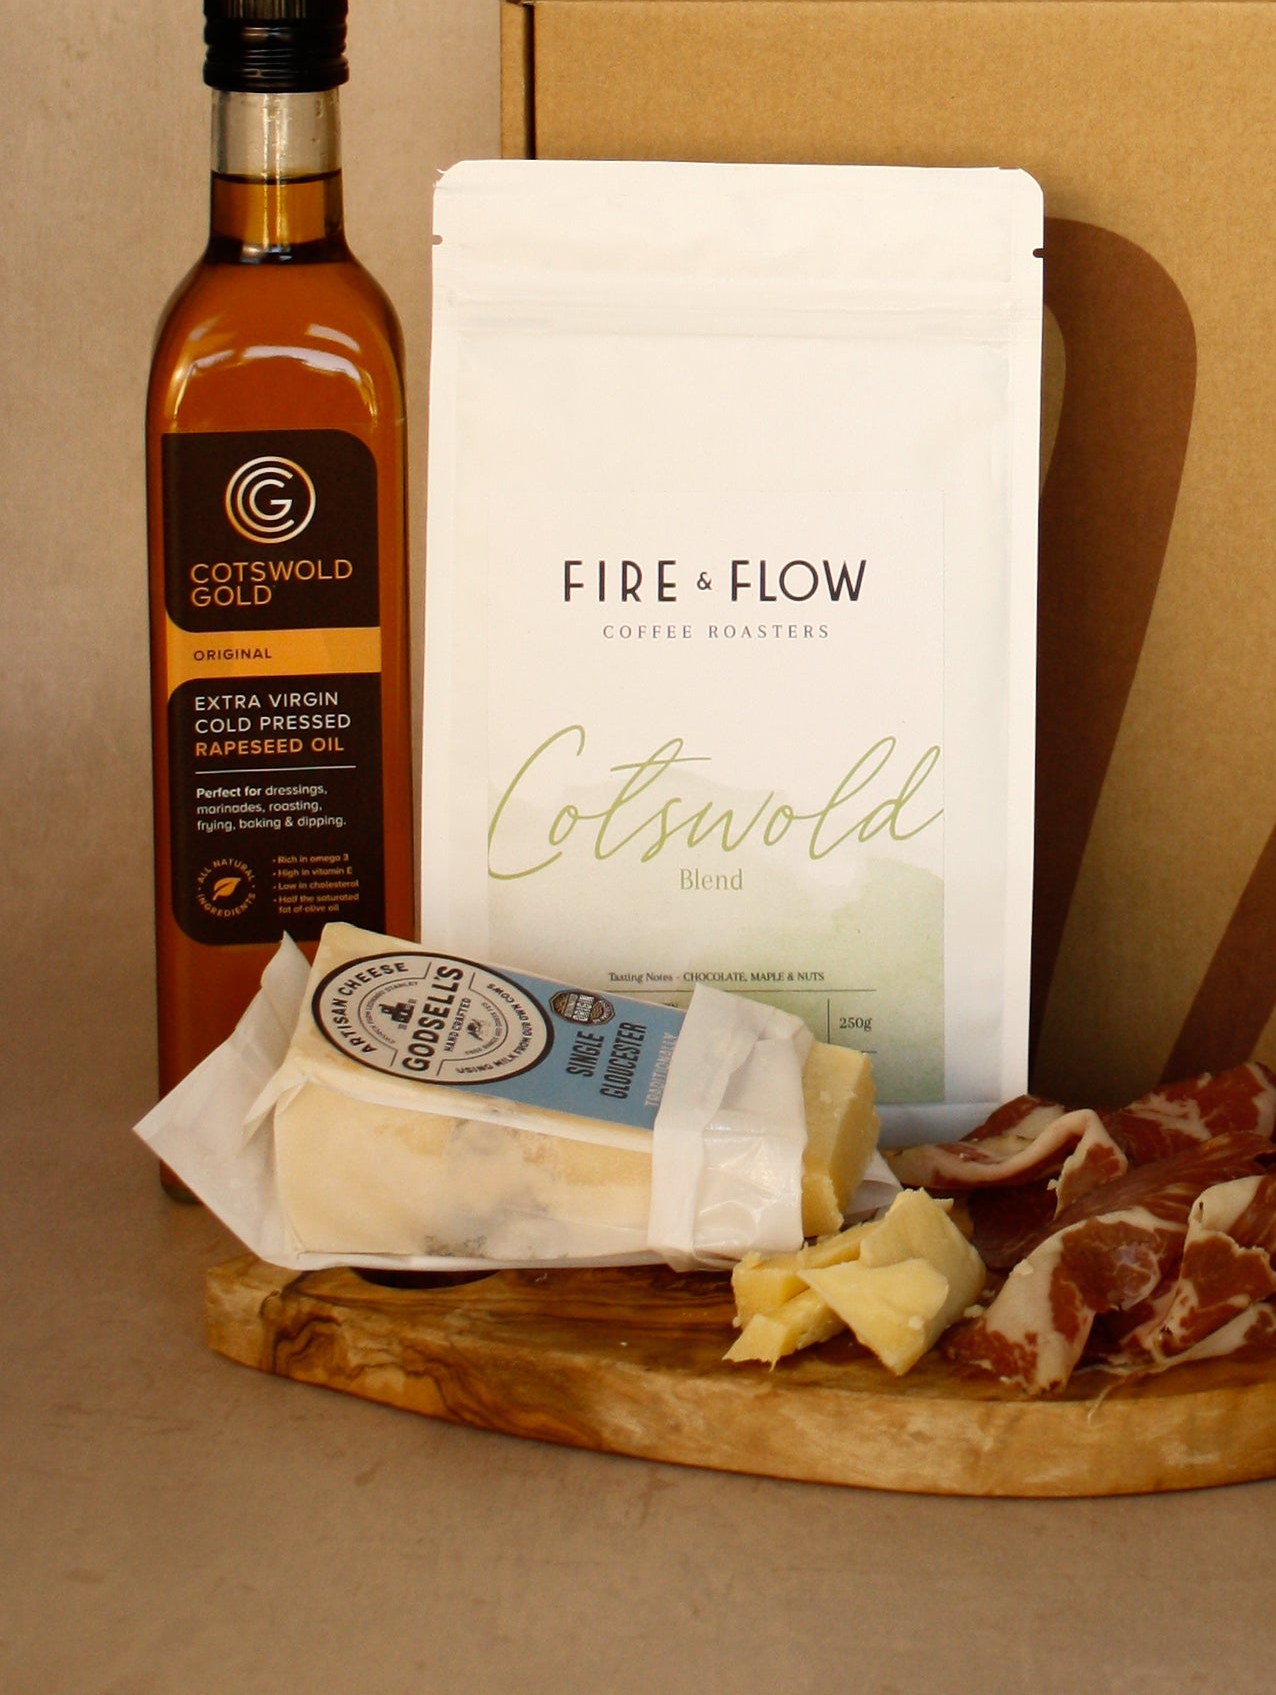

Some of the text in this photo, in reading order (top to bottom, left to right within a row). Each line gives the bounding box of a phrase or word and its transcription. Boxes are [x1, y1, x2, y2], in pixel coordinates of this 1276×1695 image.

[190, 559, 353, 584] COTSWOLD
[563, 560, 867, 602] FIRE & FLOW
[191, 585, 272, 606] GOLD
[602, 624, 830, 639] COFFEE ROASTERS
[194, 648, 272, 661] ORIGINAL
[194, 692, 339, 711] EXTRA VIRGIN
[195, 713, 351, 734] COLD PRESSED
[195, 737, 344, 756] RAPESEED OIL
[196, 786, 241, 799] Perfect
[244, 785, 262, 797] for
[487, 724, 944, 880] Cotswold
[197, 802, 265, 815] marinades,
[239, 817, 281, 830] baking
[285, 816, 294, 827] &
[277, 855, 297, 864] Rich
[679, 868, 744, 891] Blend
[338, 961, 409, 996] CHEESE
[608, 971, 643, 984] Tasting
[646, 972, 673, 982] Notes
[683, 972, 748, 983] CHOCOLATE,
[750, 972, 785, 982] MAPLE
[798, 972, 825, 982] NUTS
[332, 993, 378, 1054] ARTISAN
[839, 1016, 873, 1032] 250g
[566, 1030, 605, 1078] SINGLE
[599, 1021, 647, 1100] GLOUCESTER
